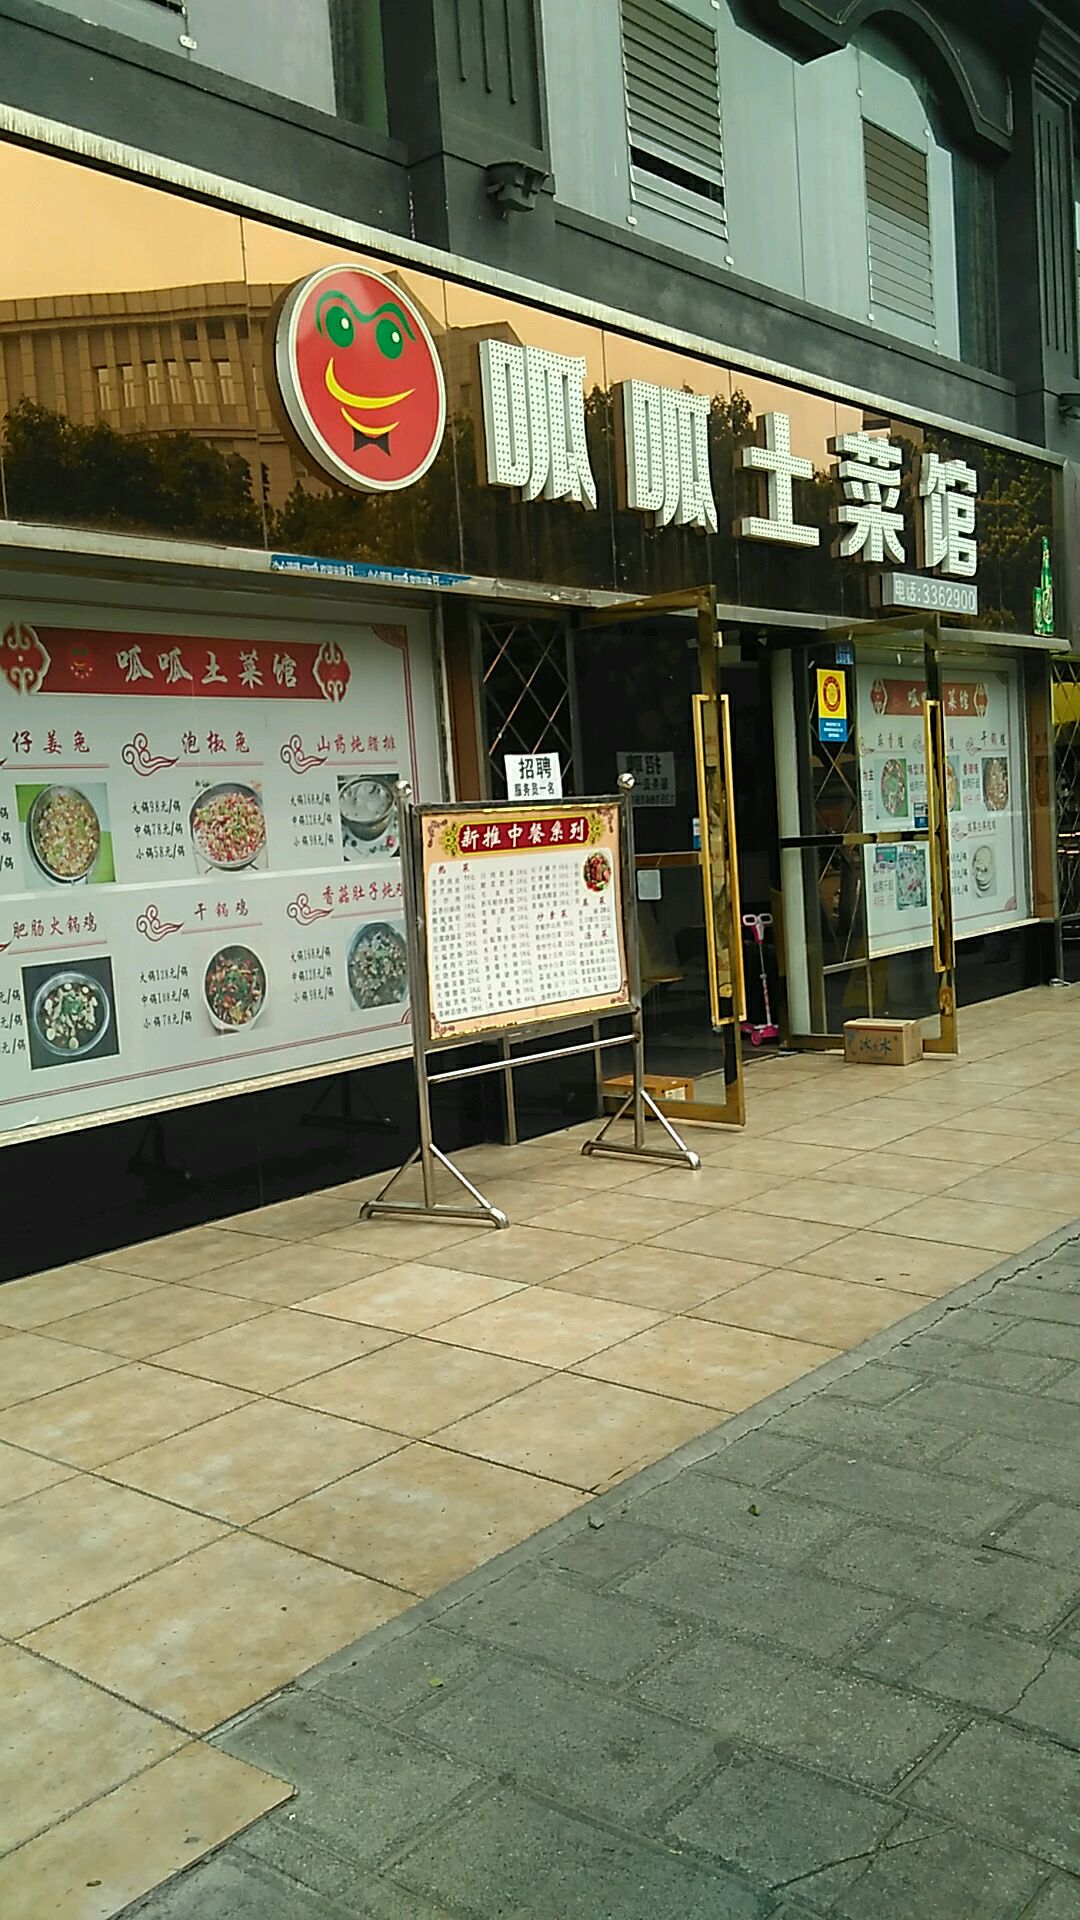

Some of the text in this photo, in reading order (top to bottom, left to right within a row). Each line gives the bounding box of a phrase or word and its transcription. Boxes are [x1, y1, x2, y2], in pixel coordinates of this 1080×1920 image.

[895, 579, 976, 611] 电话:3362900
[116, 644, 297, 690] 呱呱土菜馆
[12, 729, 91, 755] 仔姜兔
[181, 730, 250, 755] 泡椒兔
[518, 756, 552, 780] 招聘
[514, 781, 555, 797] 服务员一名
[460, 818, 585, 851] 新推中餐系列
[194, 898, 249, 921] 干锅鸡
[13, 911, 97, 940] 肥肠火锅鸡
